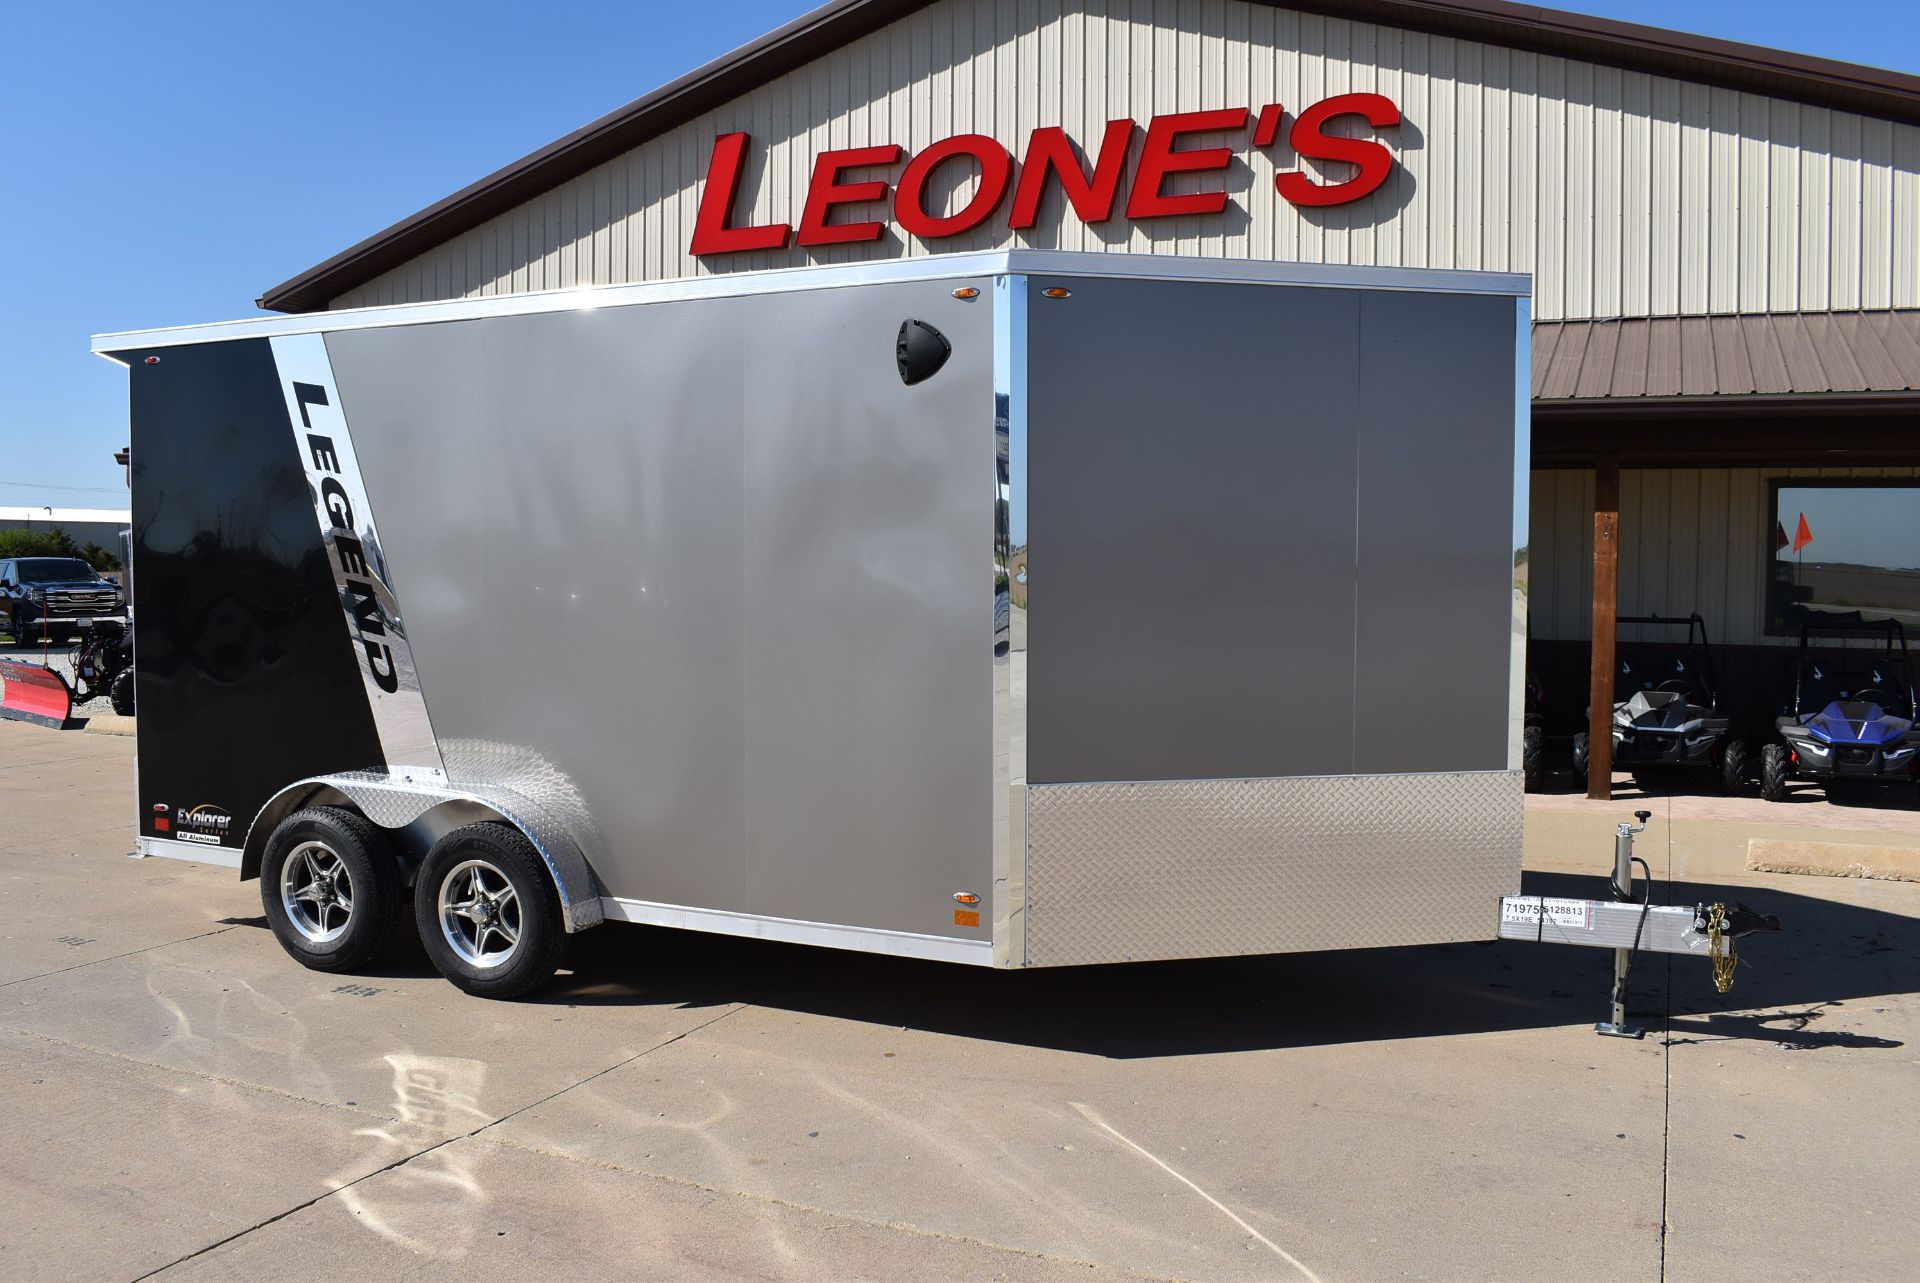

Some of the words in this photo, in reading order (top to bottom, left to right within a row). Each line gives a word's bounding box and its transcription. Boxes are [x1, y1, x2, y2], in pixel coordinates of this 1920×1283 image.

[689, 92, 1401, 256] LEONE'S
[292, 381, 399, 695] LEGEND
[177, 808, 231, 829] Explorer
[188, 835, 219, 844] Aluminum
